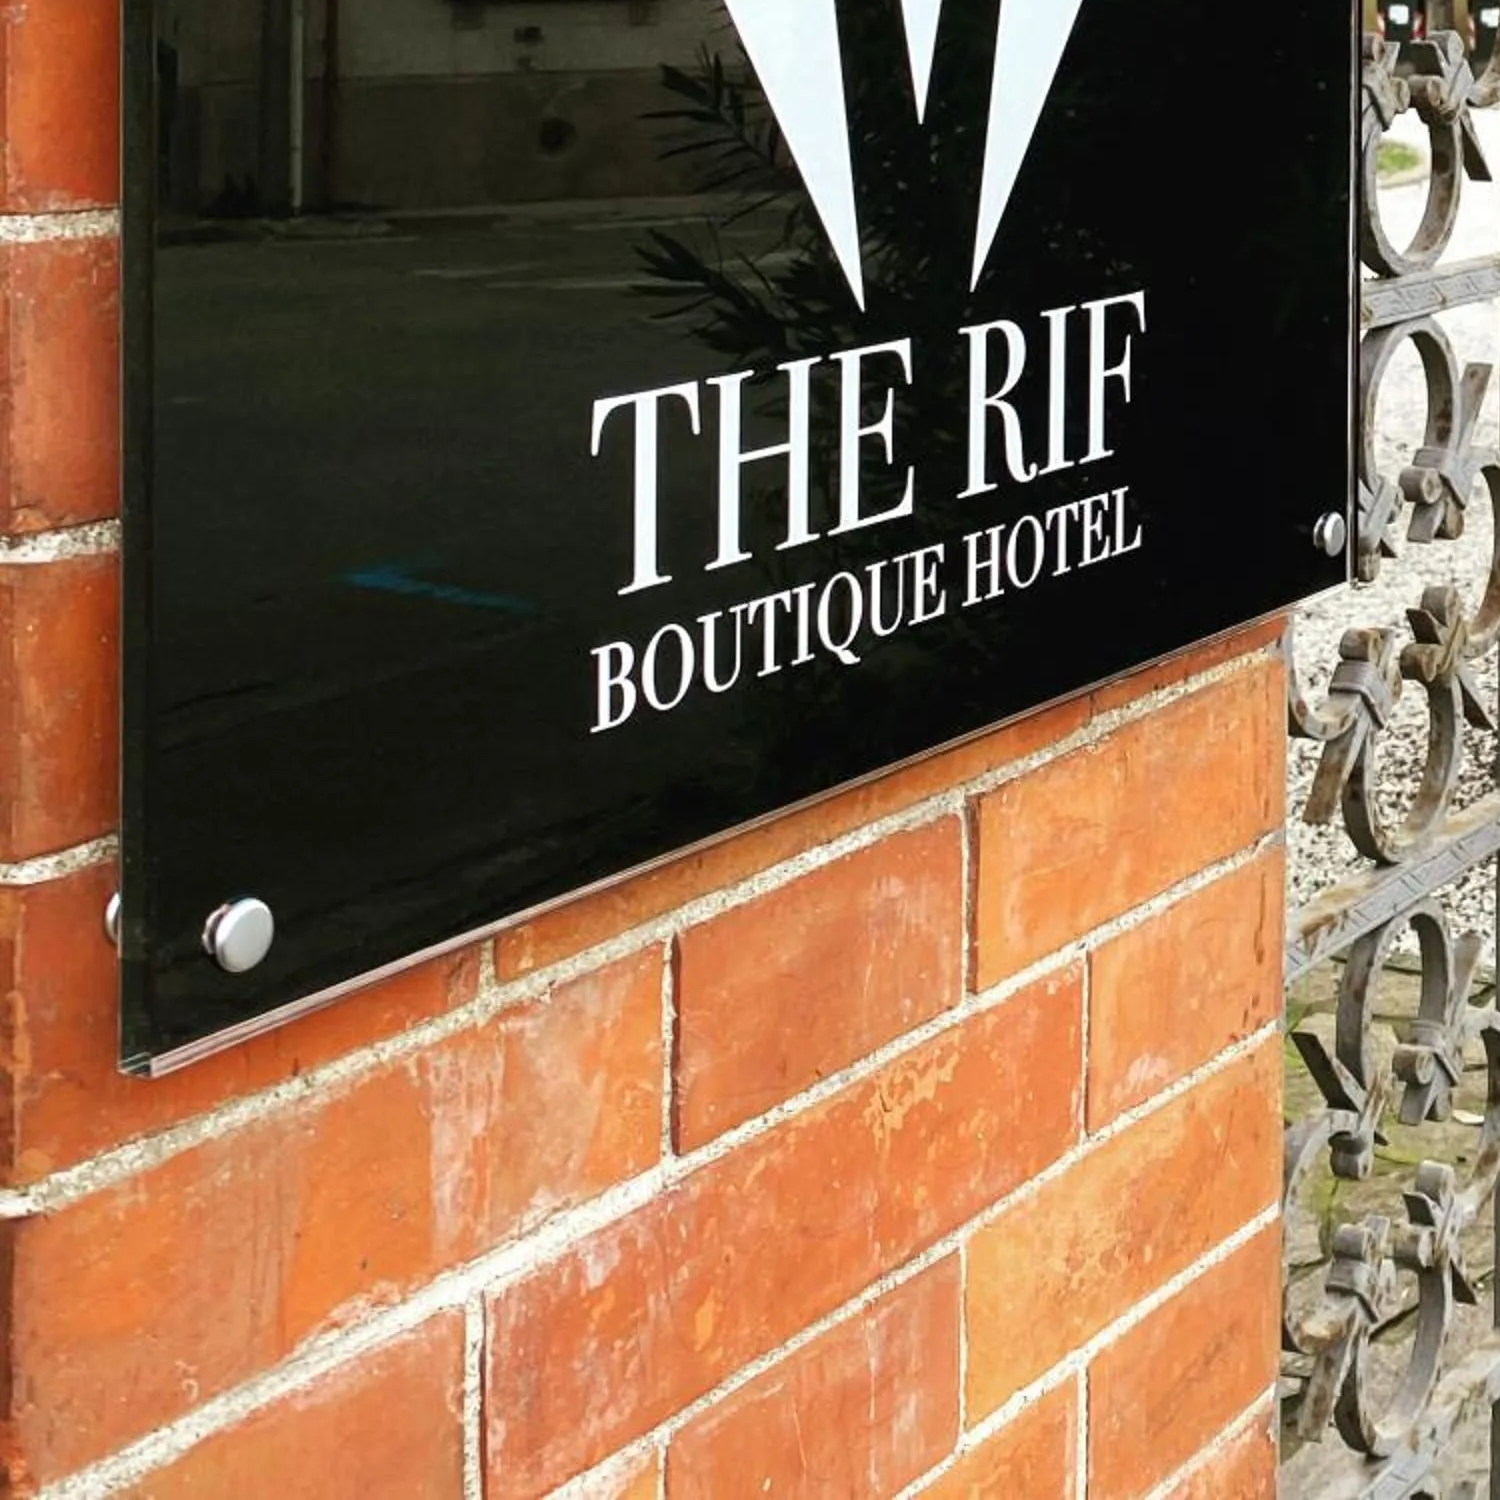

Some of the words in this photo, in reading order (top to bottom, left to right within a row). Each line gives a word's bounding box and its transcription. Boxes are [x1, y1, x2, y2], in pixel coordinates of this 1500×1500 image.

[591, 338, 914, 595] THE
[957, 291, 1145, 498] RIF
[590, 543, 946, 733] BOUTIQUE
[962, 486, 1142, 606] HOTEL
